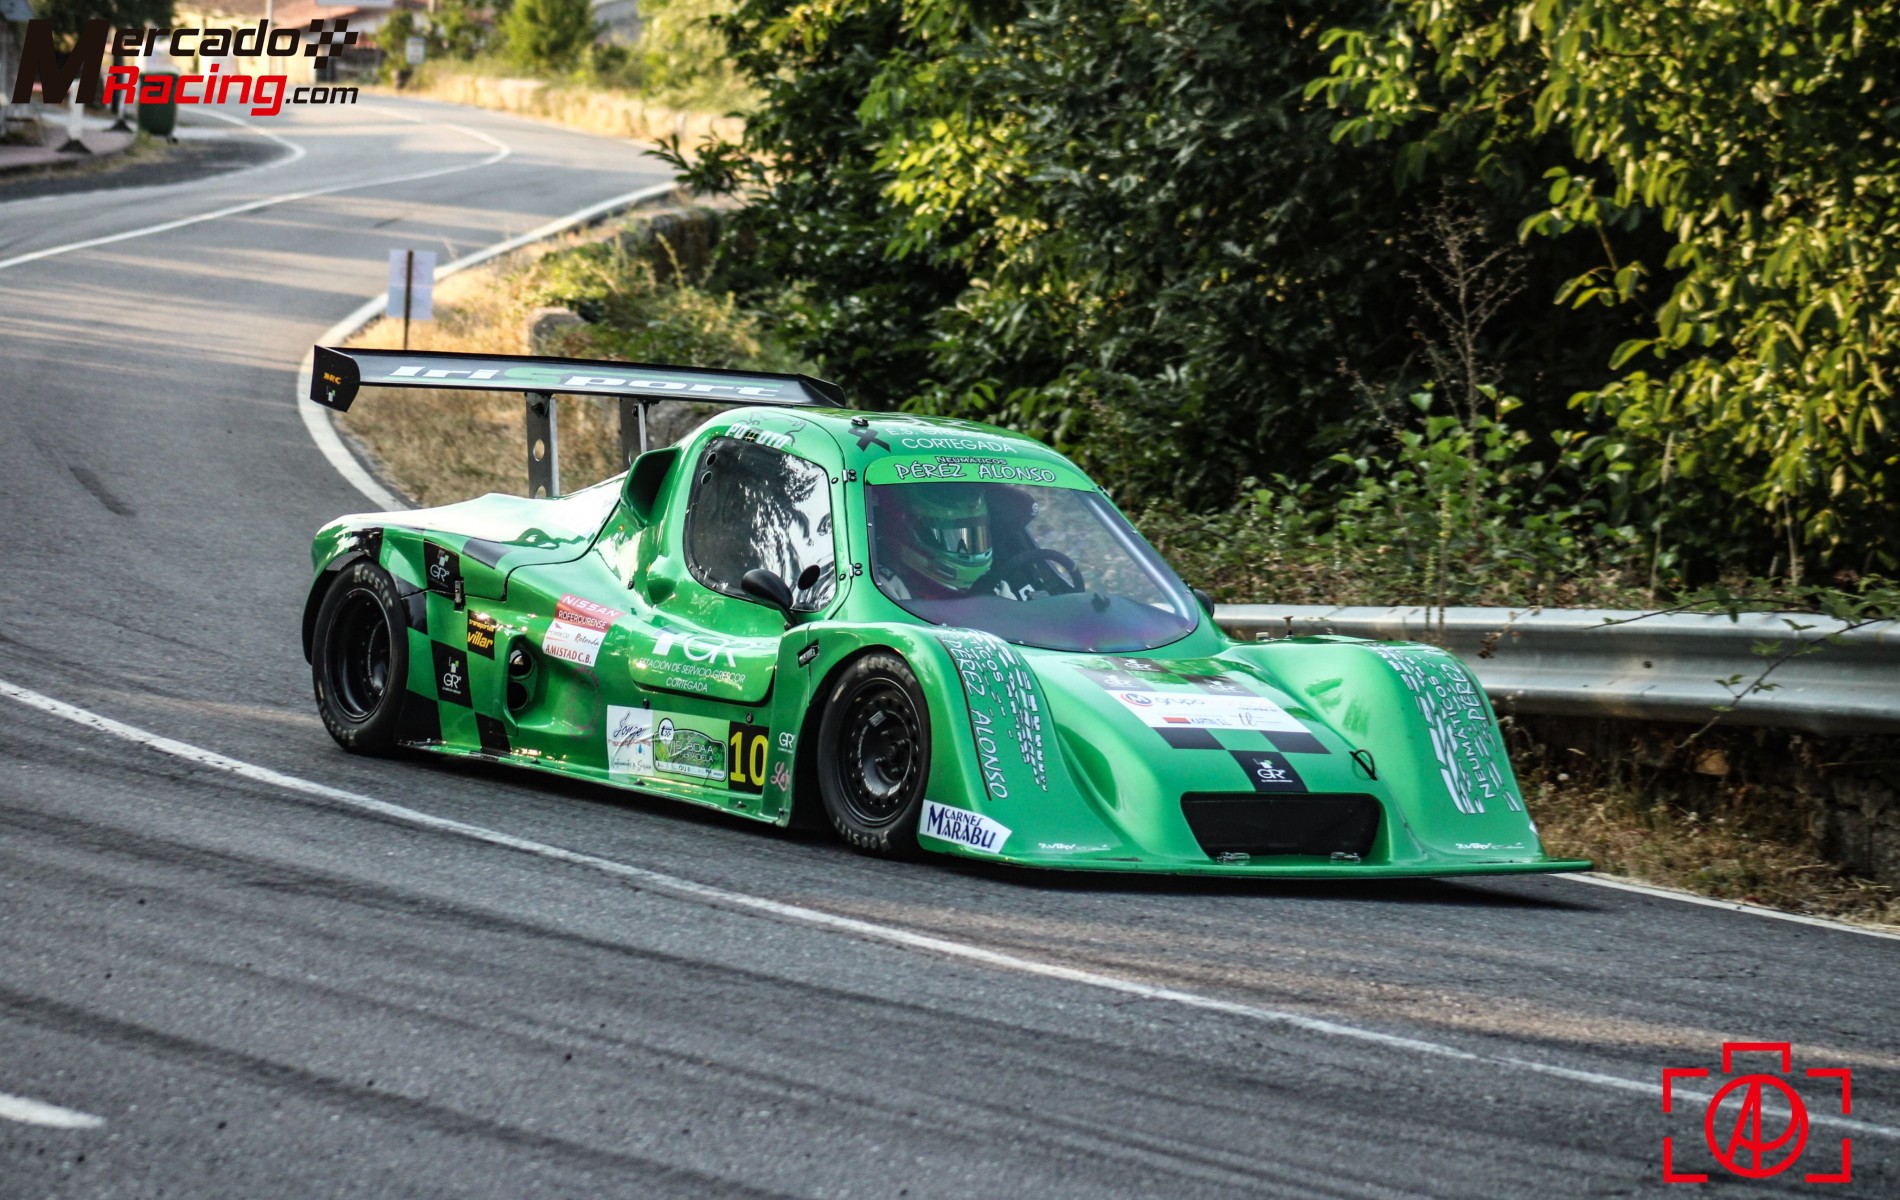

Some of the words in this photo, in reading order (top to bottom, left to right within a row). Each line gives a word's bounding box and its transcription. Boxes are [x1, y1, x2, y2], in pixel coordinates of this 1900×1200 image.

[323, 372, 342, 385] BRC
[901, 438, 1018, 454] CORTEGADA
[894, 461, 966, 480] PÉREZ
[978, 463, 1056, 483] ALONSO
[562, 595, 620, 617] NISSAN
[468, 630, 494, 649] villar
[545, 644, 577, 661] AMISTAD
[577, 652, 592, 665] C.B.
[671, 663, 682, 673] DE
[681, 664, 711, 678] SERVICIO
[665, 676, 708, 693] CORTEGADA
[730, 731, 769, 787] 10
[970, 708, 1009, 800] ALONSO
[927, 803, 997, 849] MARABU
[944, 808, 983, 827] CARNES
